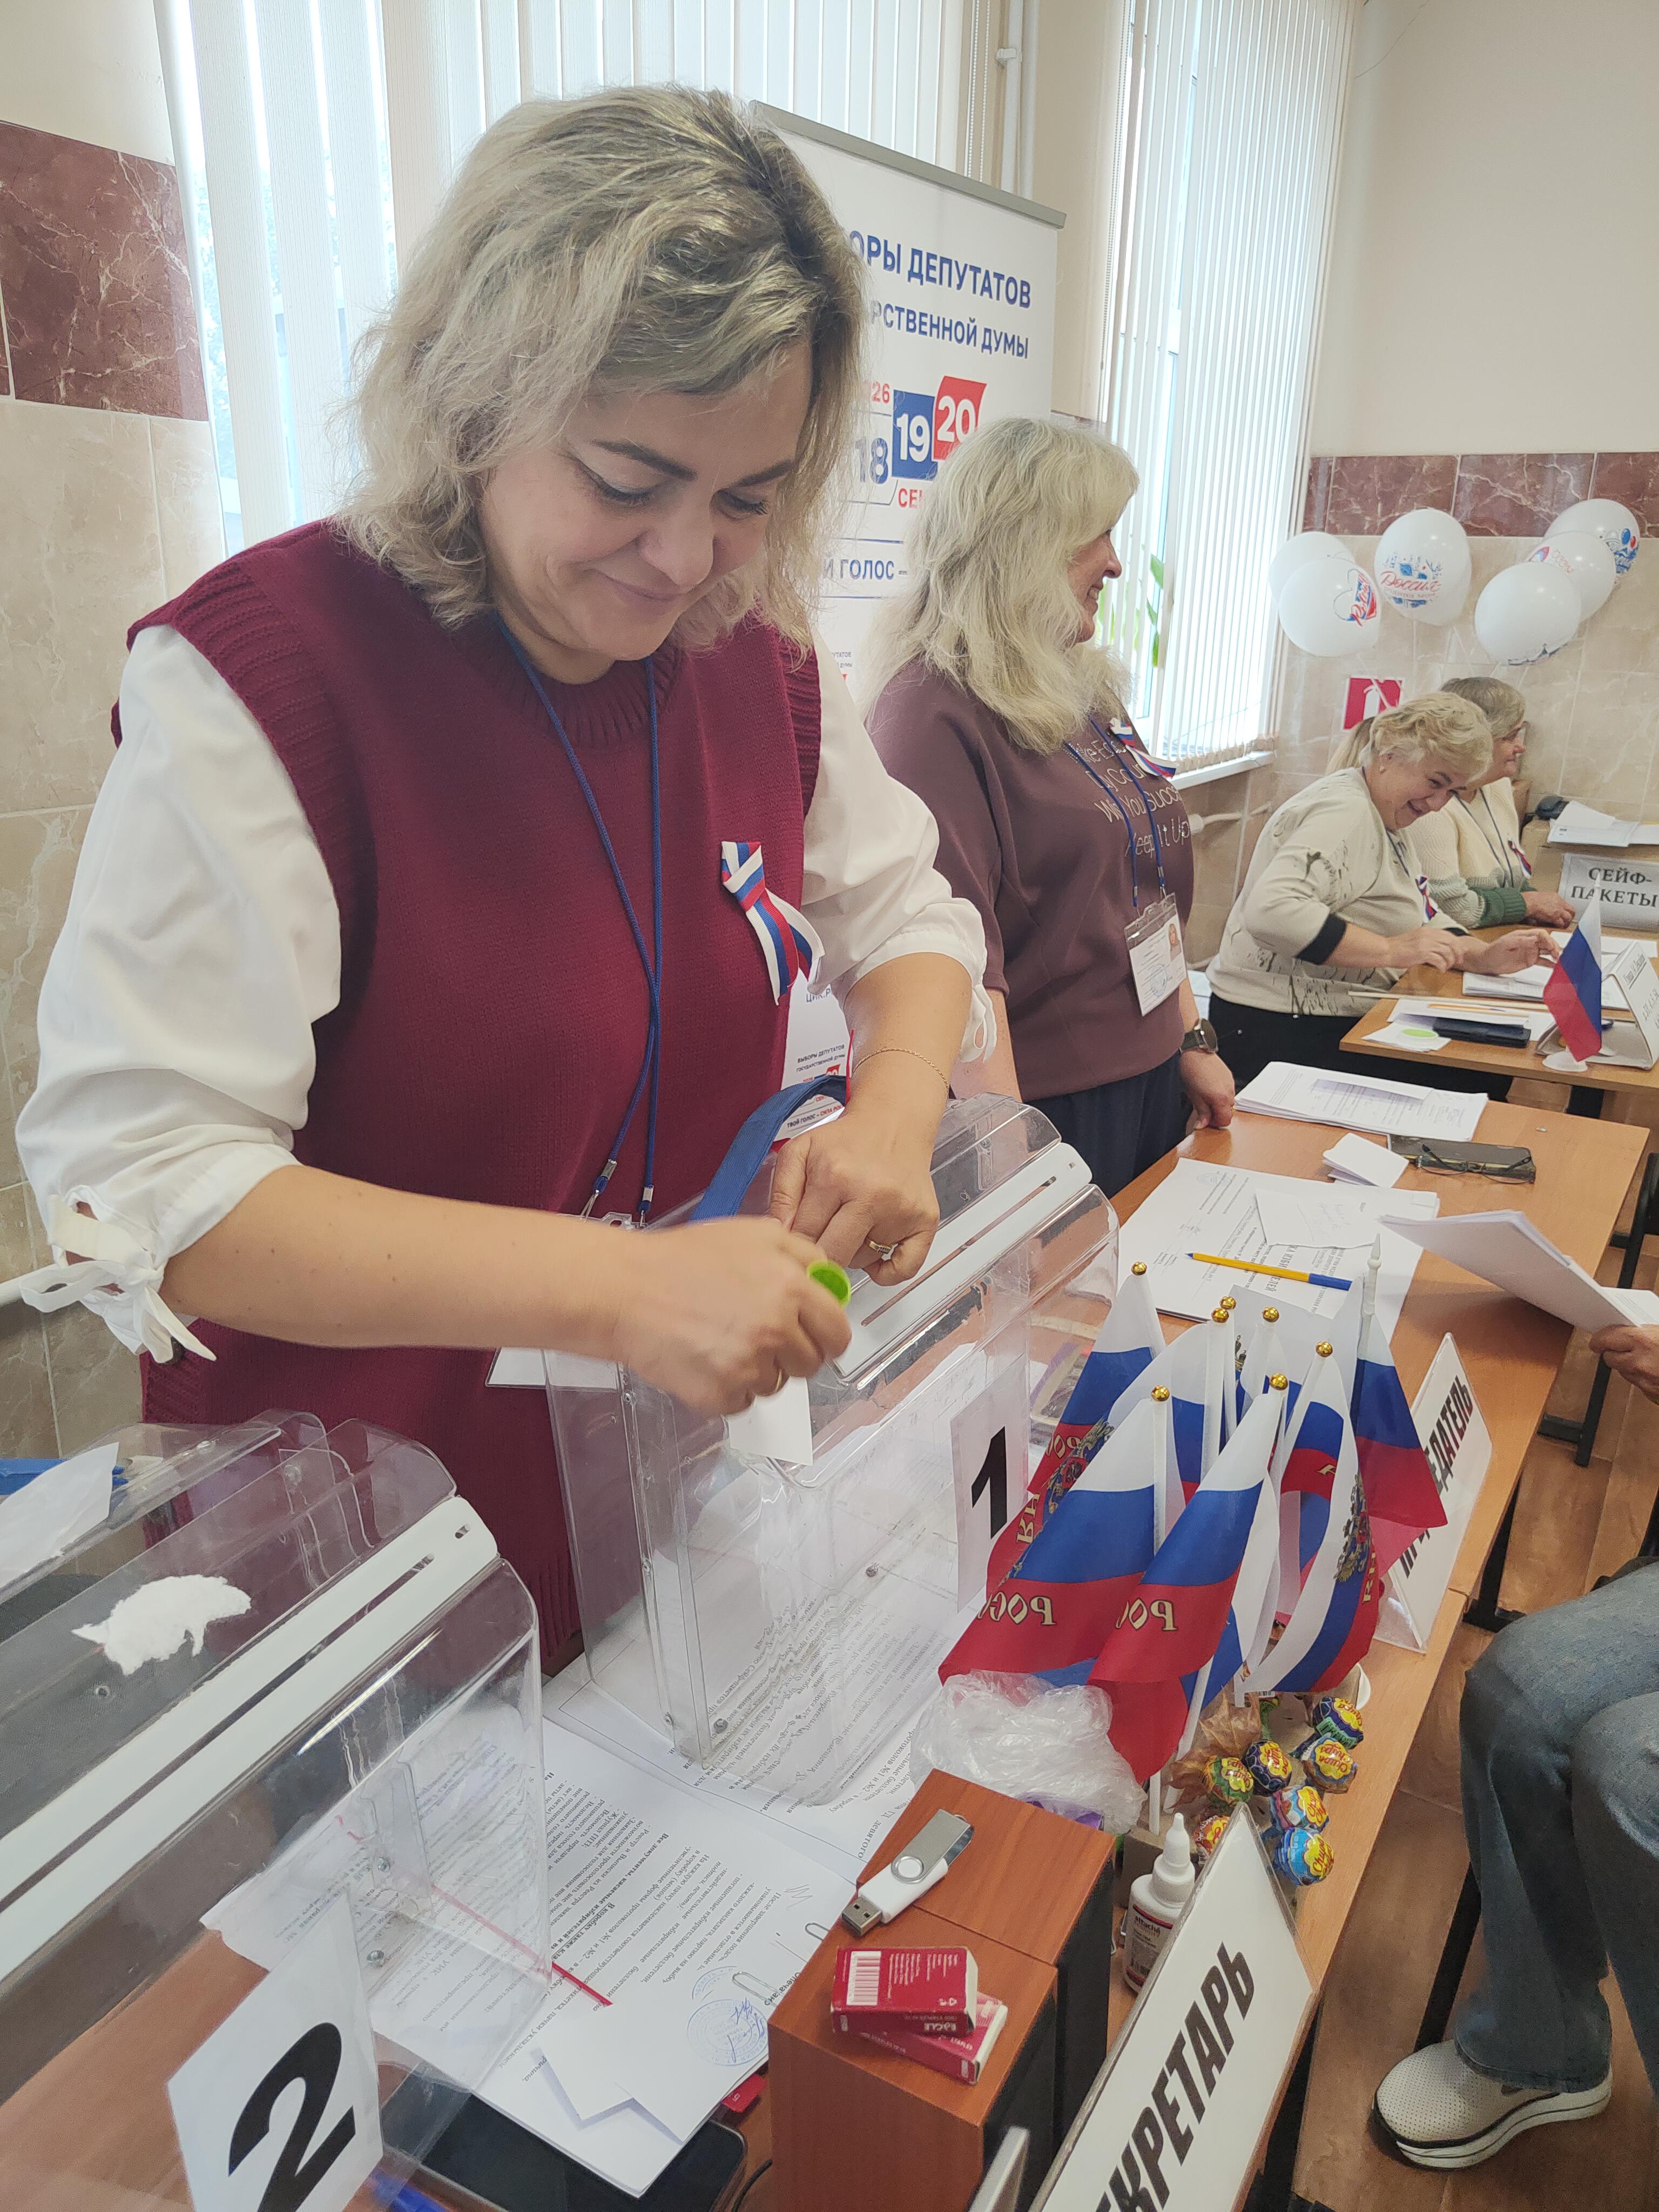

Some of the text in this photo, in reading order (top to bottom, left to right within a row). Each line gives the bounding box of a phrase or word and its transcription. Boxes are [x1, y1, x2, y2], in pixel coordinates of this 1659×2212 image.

[849, 230, 1032, 310] ОРЫ ДЕПУТАТОВ
[871, 299, 1029, 360] РСТВЕННОЙ ДУМЫ
[868, 381, 890, 403] 26
[936, 396, 976, 443] 20
[896, 413, 931, 463] 19
[855, 436, 888, 484] 18
[840, 558, 894, 581] ГОЛОС
[1588, 867, 1653, 887] СЕЙФ-
[1570, 885, 1658, 909] ПАКЕТЫ
[796, 1056, 833, 1073] ГОСУДАРСТВЕННОЙ
[797, 1044, 845, 1064] ВЫБОРЫ ДЕПУТАТОВ
[787, 1117, 800, 1129] ТВОЙ
[800, 1112, 816, 1124] ГОЛОС
[1264, 1252, 1293, 1292] ИЗБИЕЛЕЙ
[971, 1425, 1008, 1540] 1
[876, 1765, 889, 1777] №1
[543, 1786, 571, 1816] акт (акты)
[549, 1782, 564, 1797] акты
[571, 1786, 582, 1798] вне
[861, 1782, 875, 1792] №2
[557, 1790, 590, 1823] решающего
[562, 1799, 593, 1830] Ведомость
[545, 1798, 605, 1859] решающего голоса для
[578, 1808, 609, 1838] Ведомость
[580, 1810, 618, 1849] Журнал ППЗ;
[589, 1810, 629, 1850] упакованные;
[605, 1815, 636, 1846] -Заявления
[628, 1827, 649, 1848] Реестр
[655, 1832, 667, 1844] Все
[551, 1838, 578, 1865] передачи
[596, 1845, 608, 1857] для
[858, 1819, 882, 1859] девятого
[560, 1819, 644, 1903] возможности проголосовать вне
[563, 1855, 598, 1889] голосования
[599, 1852, 626, 1879] Выписки
[623, 1843, 657, 1878] документы,
[654, 1844, 692, 1884] -увеличенные
[673, 1853, 697, 1878] коробку
[553, 1887, 564, 1898] вне
[570, 1884, 594, 1908] Реестра
[592, 1878, 600, 1886] из
[598, 1877, 626, 1905] касаемые
[637, 1882, 658, 1904] формы
[652, 1876, 677, 1902] (мешок)
[676, 1860, 721, 1911] подписи, печать);
[679, 1866, 729, 1920] -недействительные
[731, 1881, 756, 1908] -каждого
[562, 1902, 599, 1940] избирателей
[582, 1906, 608, 1932] коробку
[607, 1901, 639, 1934] протоколов
[705, 1906, 734, 1938] кандидата,
[731, 1885, 772, 1931] упаковываются
[734, 1891, 781, 1943] После завершения
[535, 1854, 709, 2031] На каждую пачку наклеивается соответствующая тикетка, пачки
[563, 1930, 583, 1949] также
[598, 1932, 609, 1944] №1
[638, 1921, 680, 1963] избирательные
[639, 1876, 740, 1986] погашенные избирательные бюллетени,
[582, 1947, 594, 1959] №2
[679, 1959, 687, 1967] на
[684, 1936, 707, 1960] партию
[702, 1934, 730, 1965] отдельные
[605, 1965, 638, 1999] бюллетени
[520, 2056, 547, 2084] ричина,
[1094, 1941, 1256, 2212] КРЕТАРЬ
[228, 2022, 359, 2212] 2
